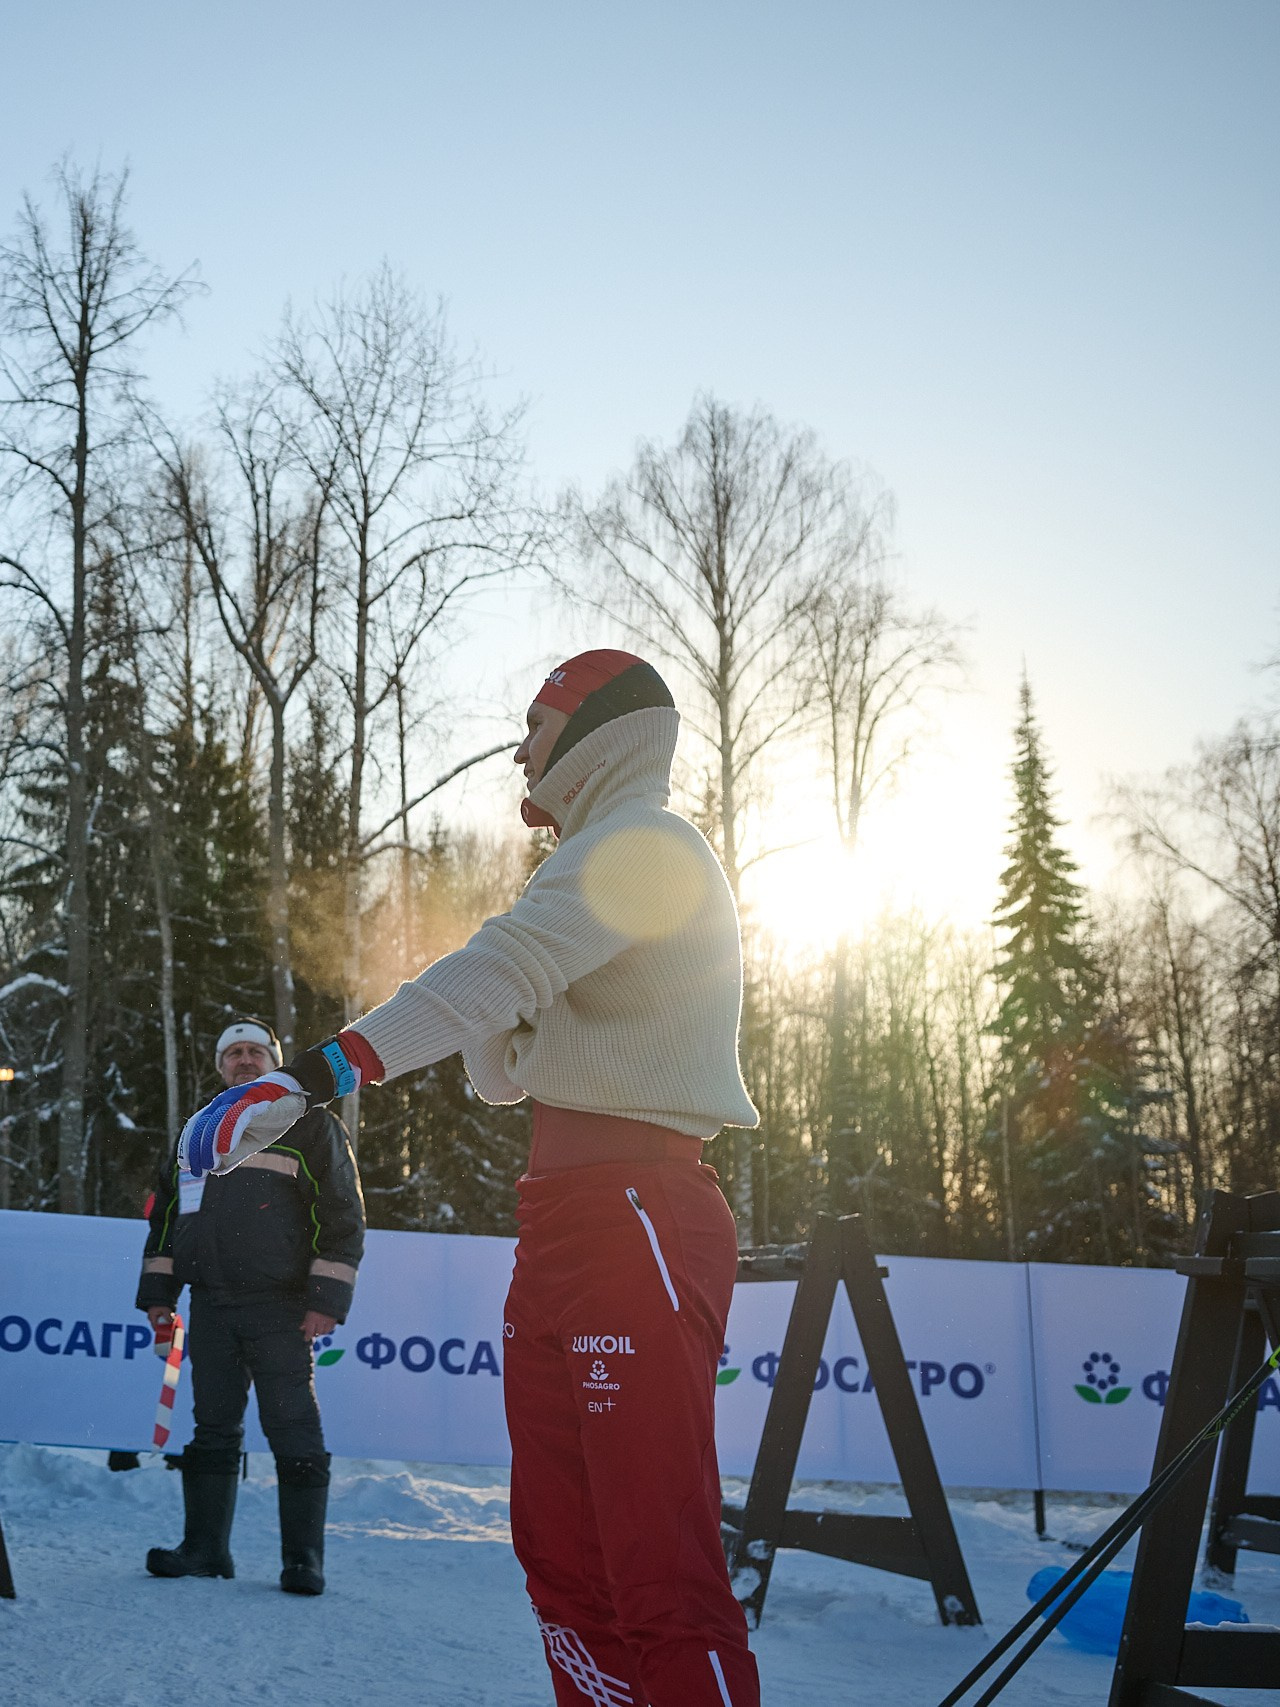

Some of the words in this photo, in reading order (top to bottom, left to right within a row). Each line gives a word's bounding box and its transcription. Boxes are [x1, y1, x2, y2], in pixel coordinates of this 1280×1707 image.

[572, 1335, 636, 1354] LUKOIL
[356, 1332, 502, 1377] ФОСА
[582, 1381, 621, 1391] PHOSAGRO
